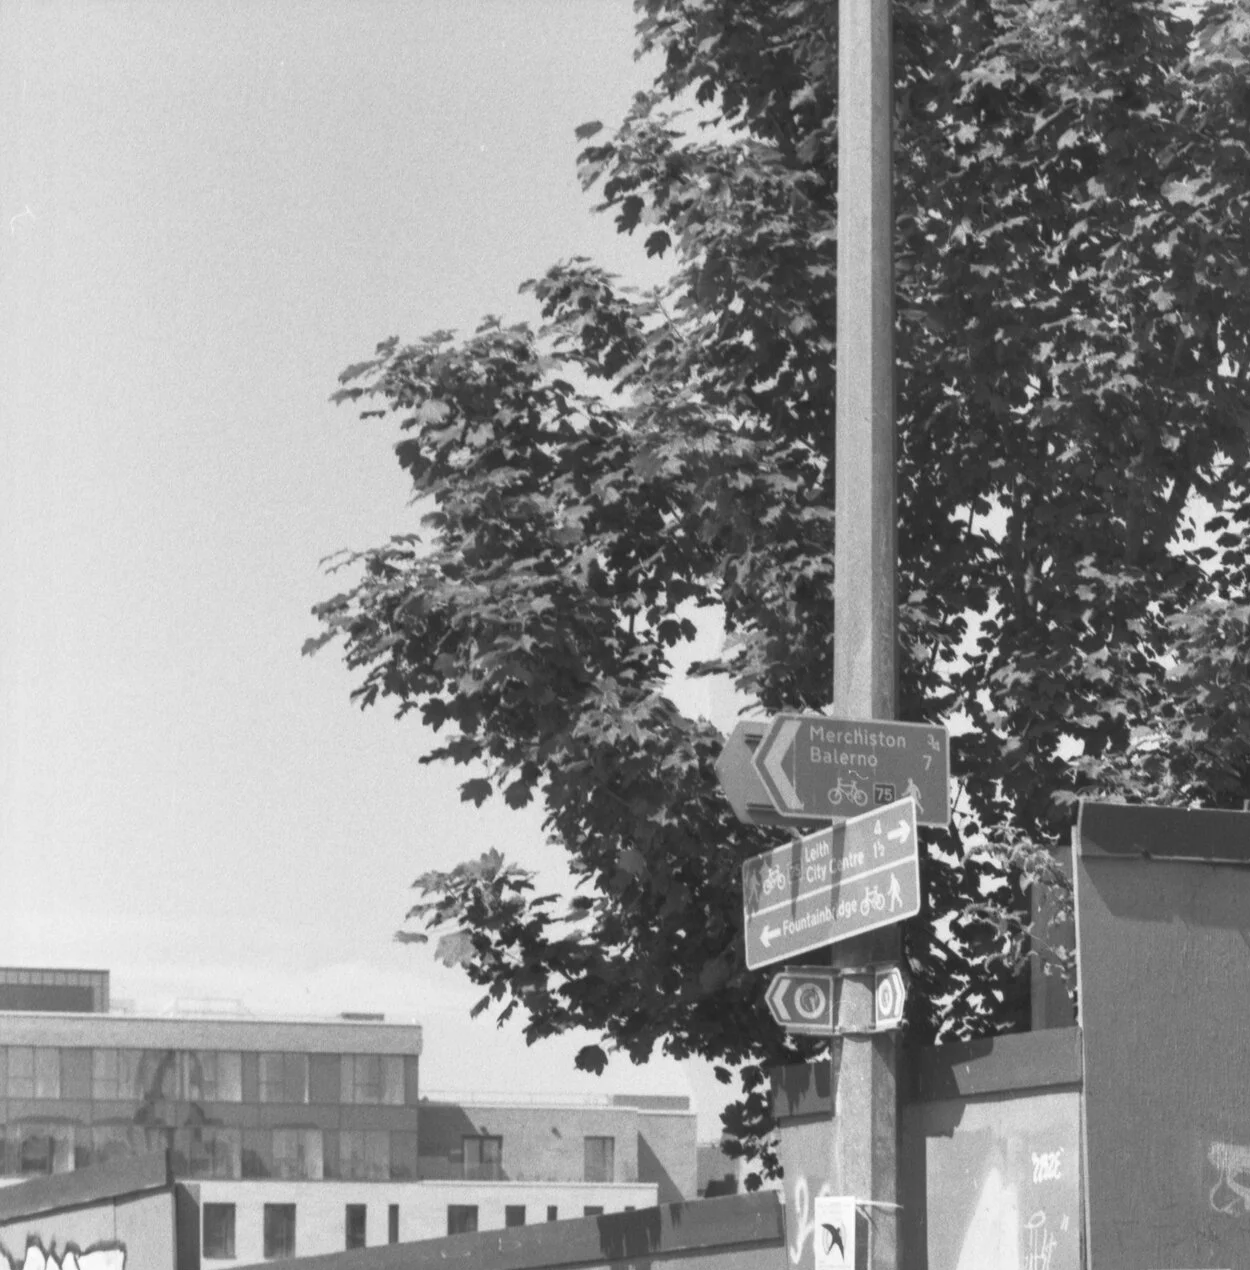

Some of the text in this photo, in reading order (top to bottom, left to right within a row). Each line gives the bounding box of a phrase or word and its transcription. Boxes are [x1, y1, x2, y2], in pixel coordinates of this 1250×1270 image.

[809, 725, 907, 748] Merchiston
[810, 746, 933, 771] Balerno 7
[876, 788, 893, 801] 75
[804, 840, 830, 863] Leith
[806, 863, 828, 883] City
[782, 898, 858, 936] Fountainbdge
